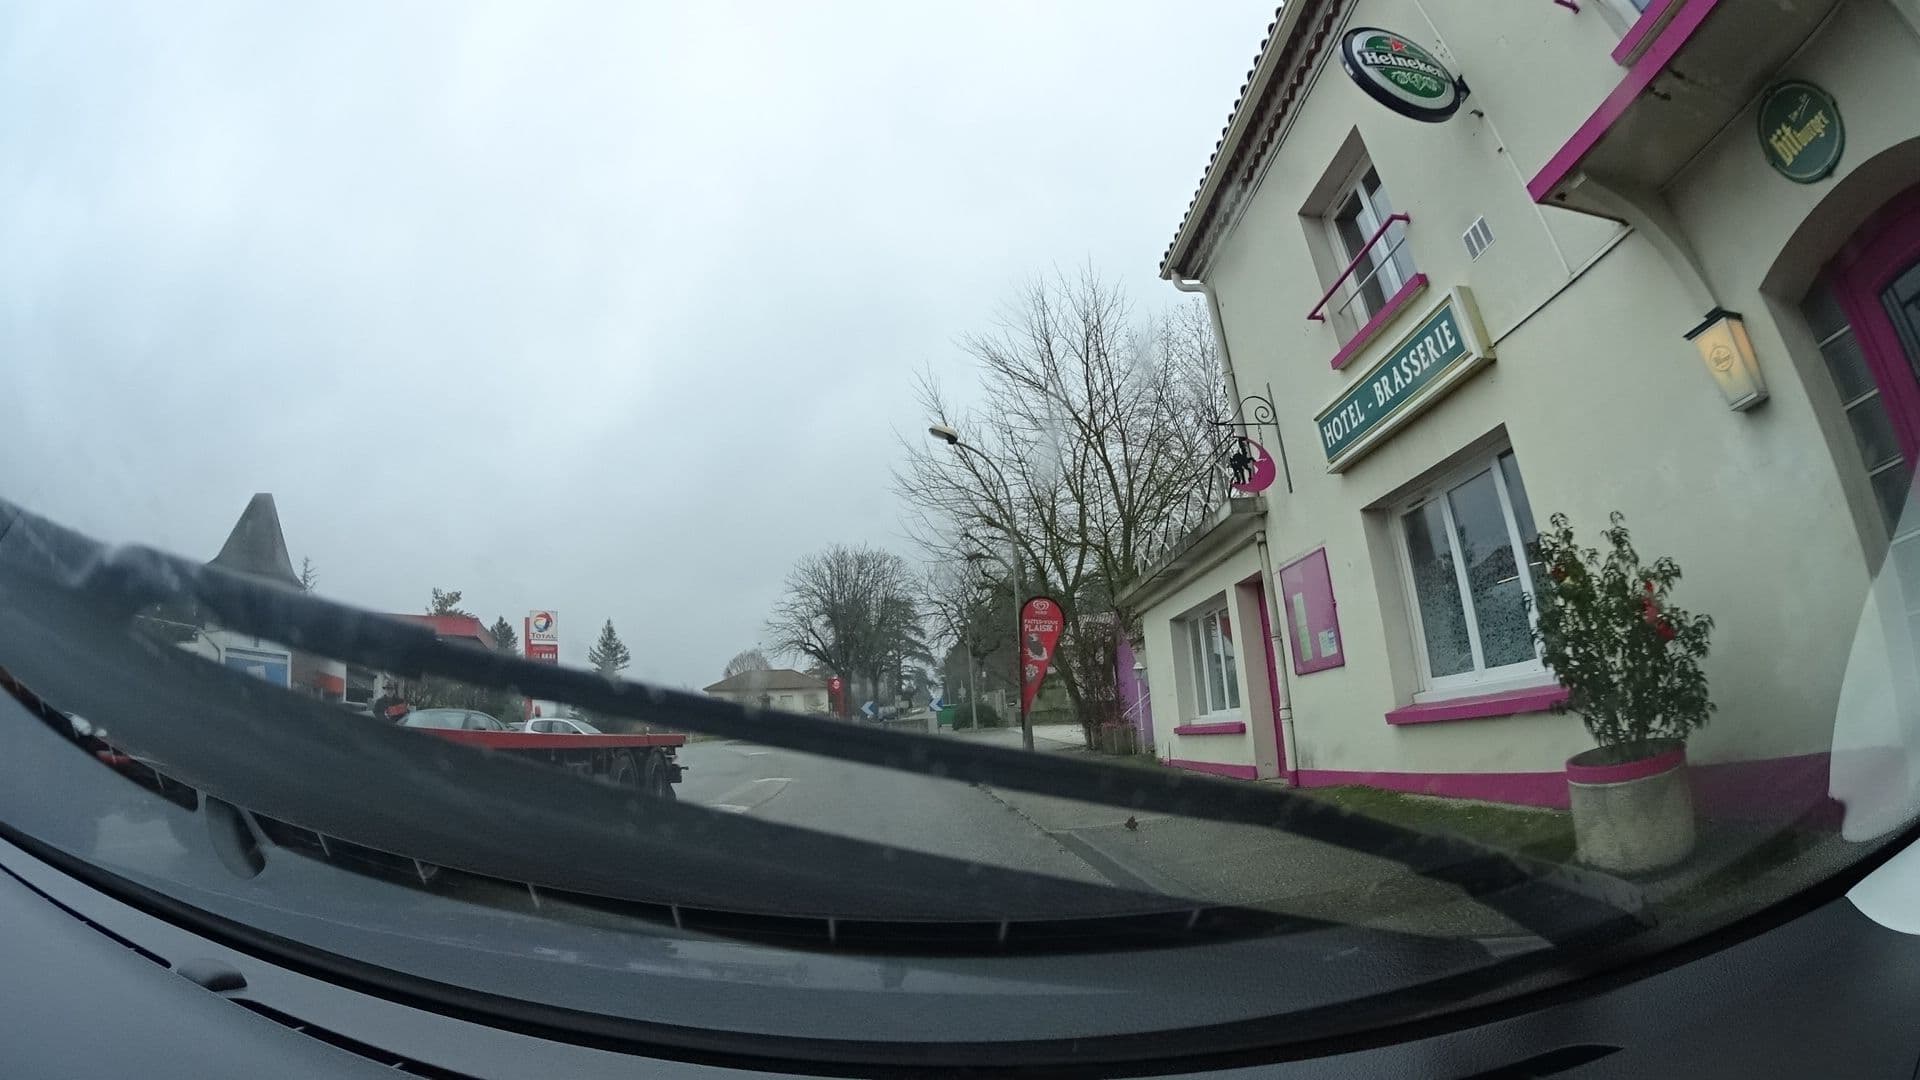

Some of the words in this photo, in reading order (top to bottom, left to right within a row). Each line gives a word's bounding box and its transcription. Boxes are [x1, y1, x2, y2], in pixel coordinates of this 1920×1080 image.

[1361, 51, 1441, 77] Heineken
[1323, 399, 1366, 449] HOTEL
[1372, 319, 1457, 408] BRASSERIE
